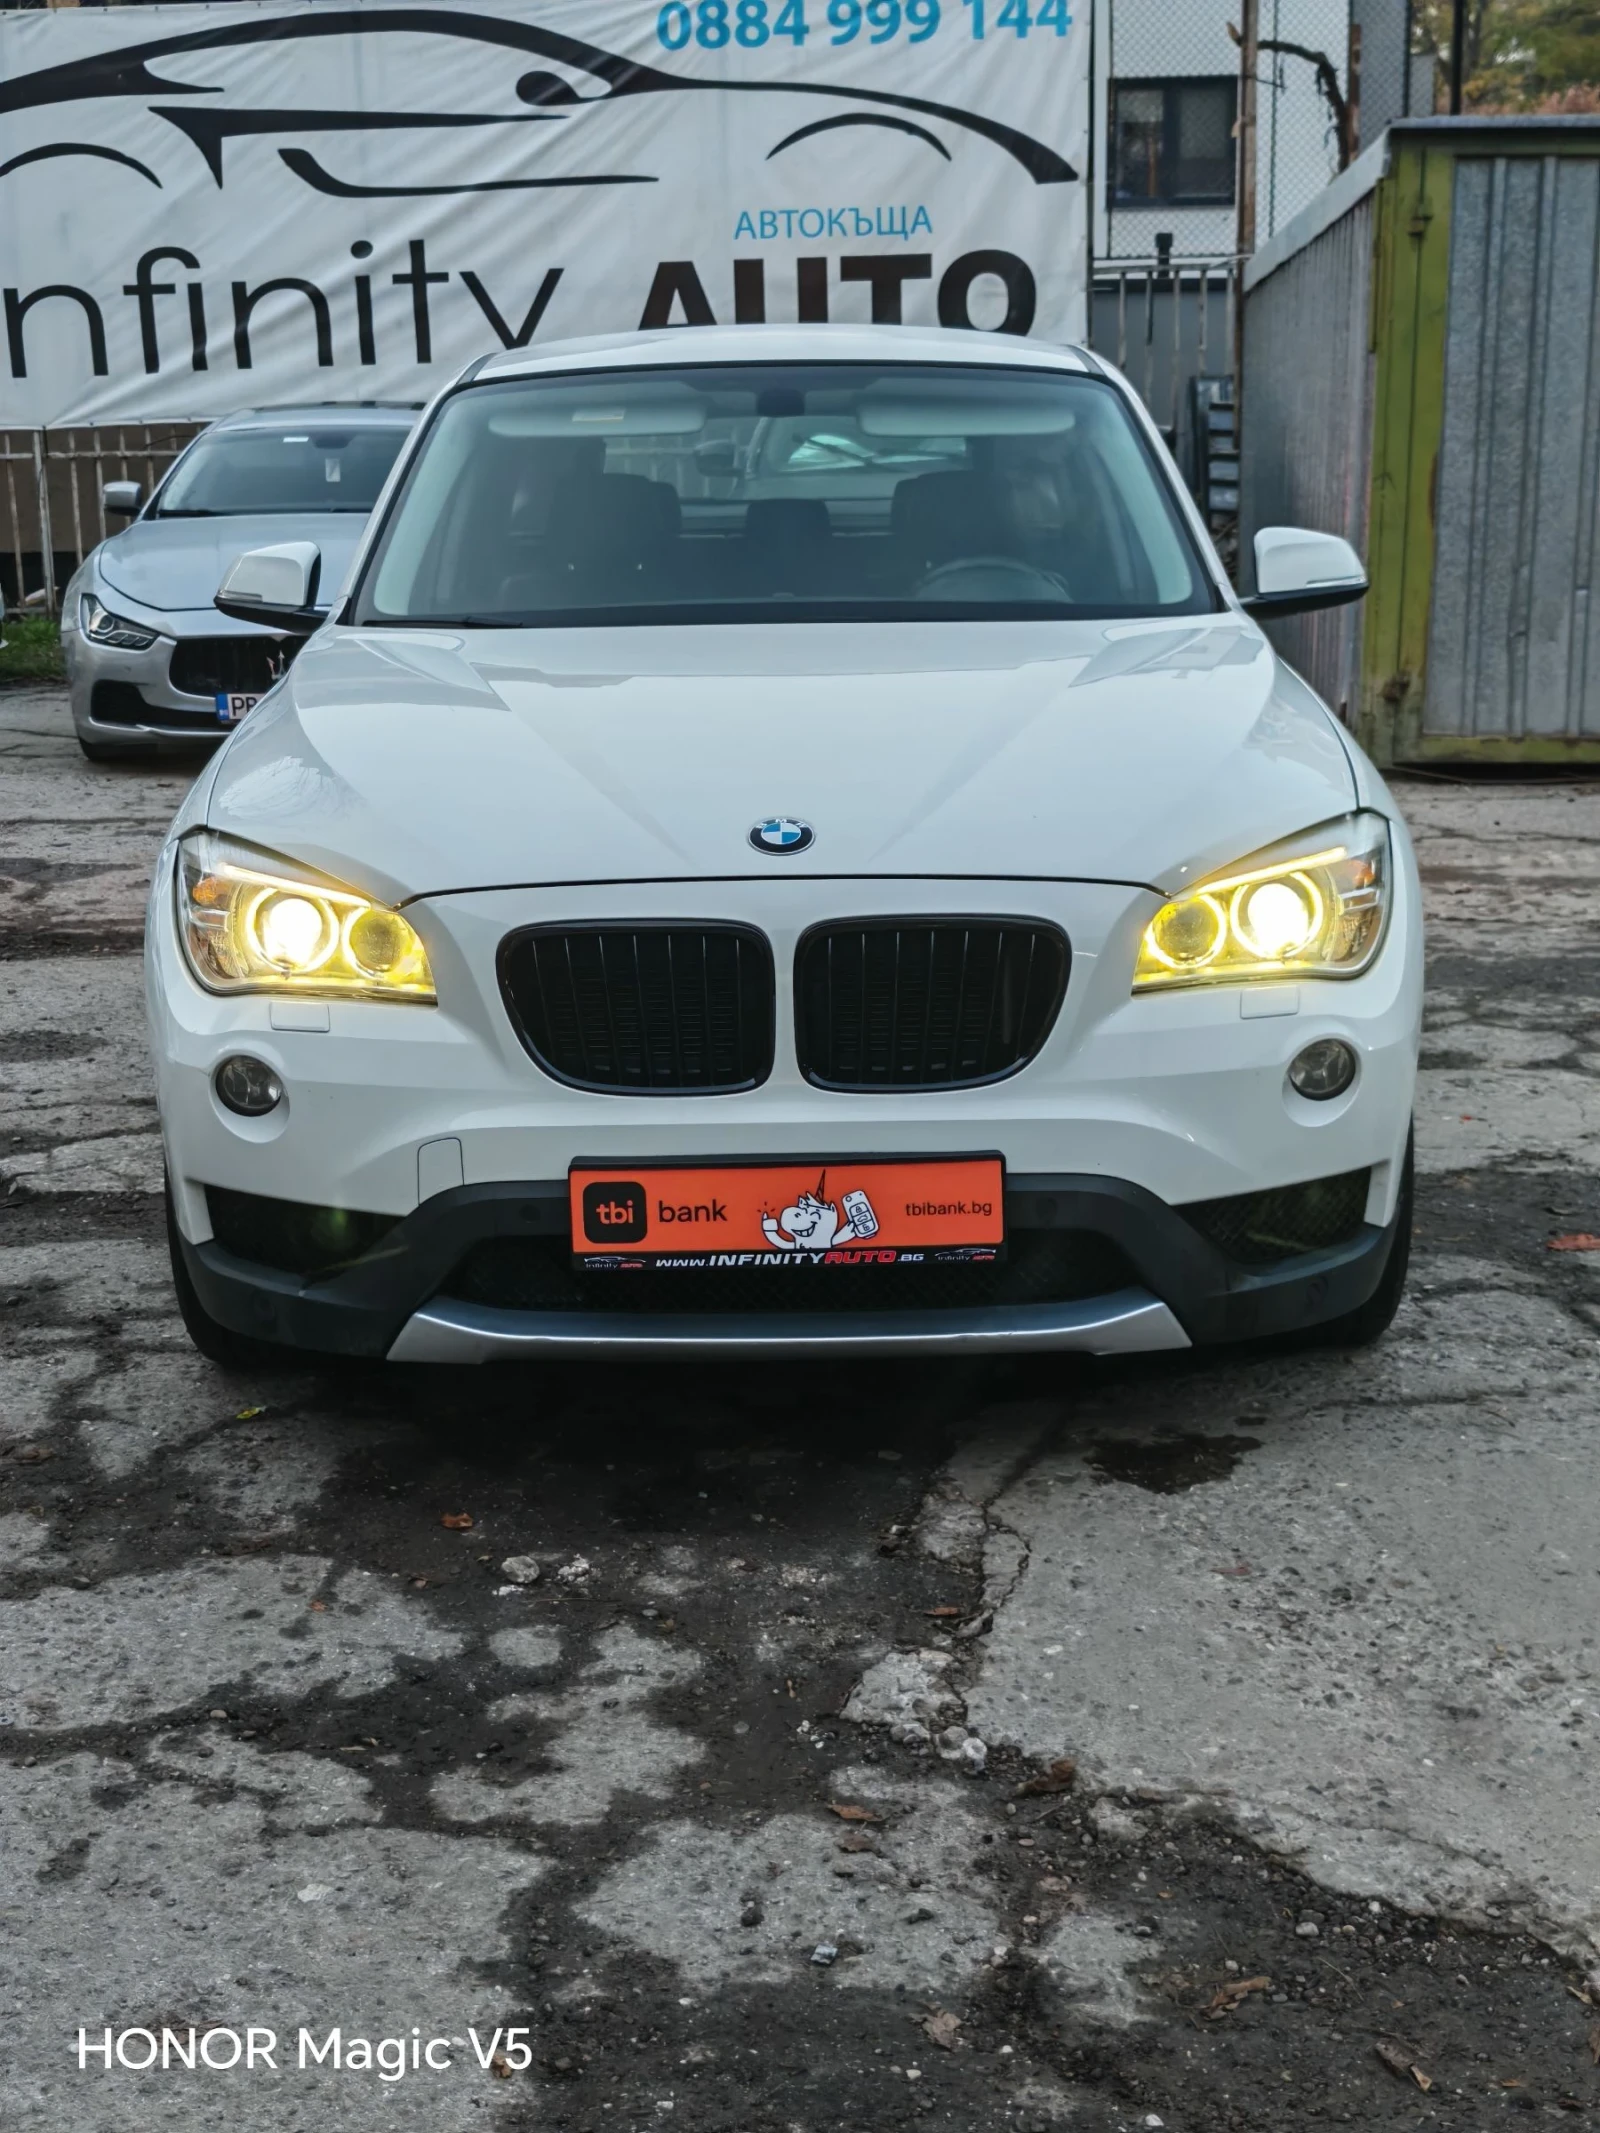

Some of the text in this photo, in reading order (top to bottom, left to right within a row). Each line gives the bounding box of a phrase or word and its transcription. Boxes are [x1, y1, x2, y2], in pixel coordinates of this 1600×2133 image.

[656, 0, 1072, 50] 0884 999 144
[734, 205, 933, 241] АВТОКЪЩА
[638, 249, 1036, 337] AUTO
[596, 1199, 728, 1224] tbi bank
[905, 1201, 993, 1216] tbibank.bg
